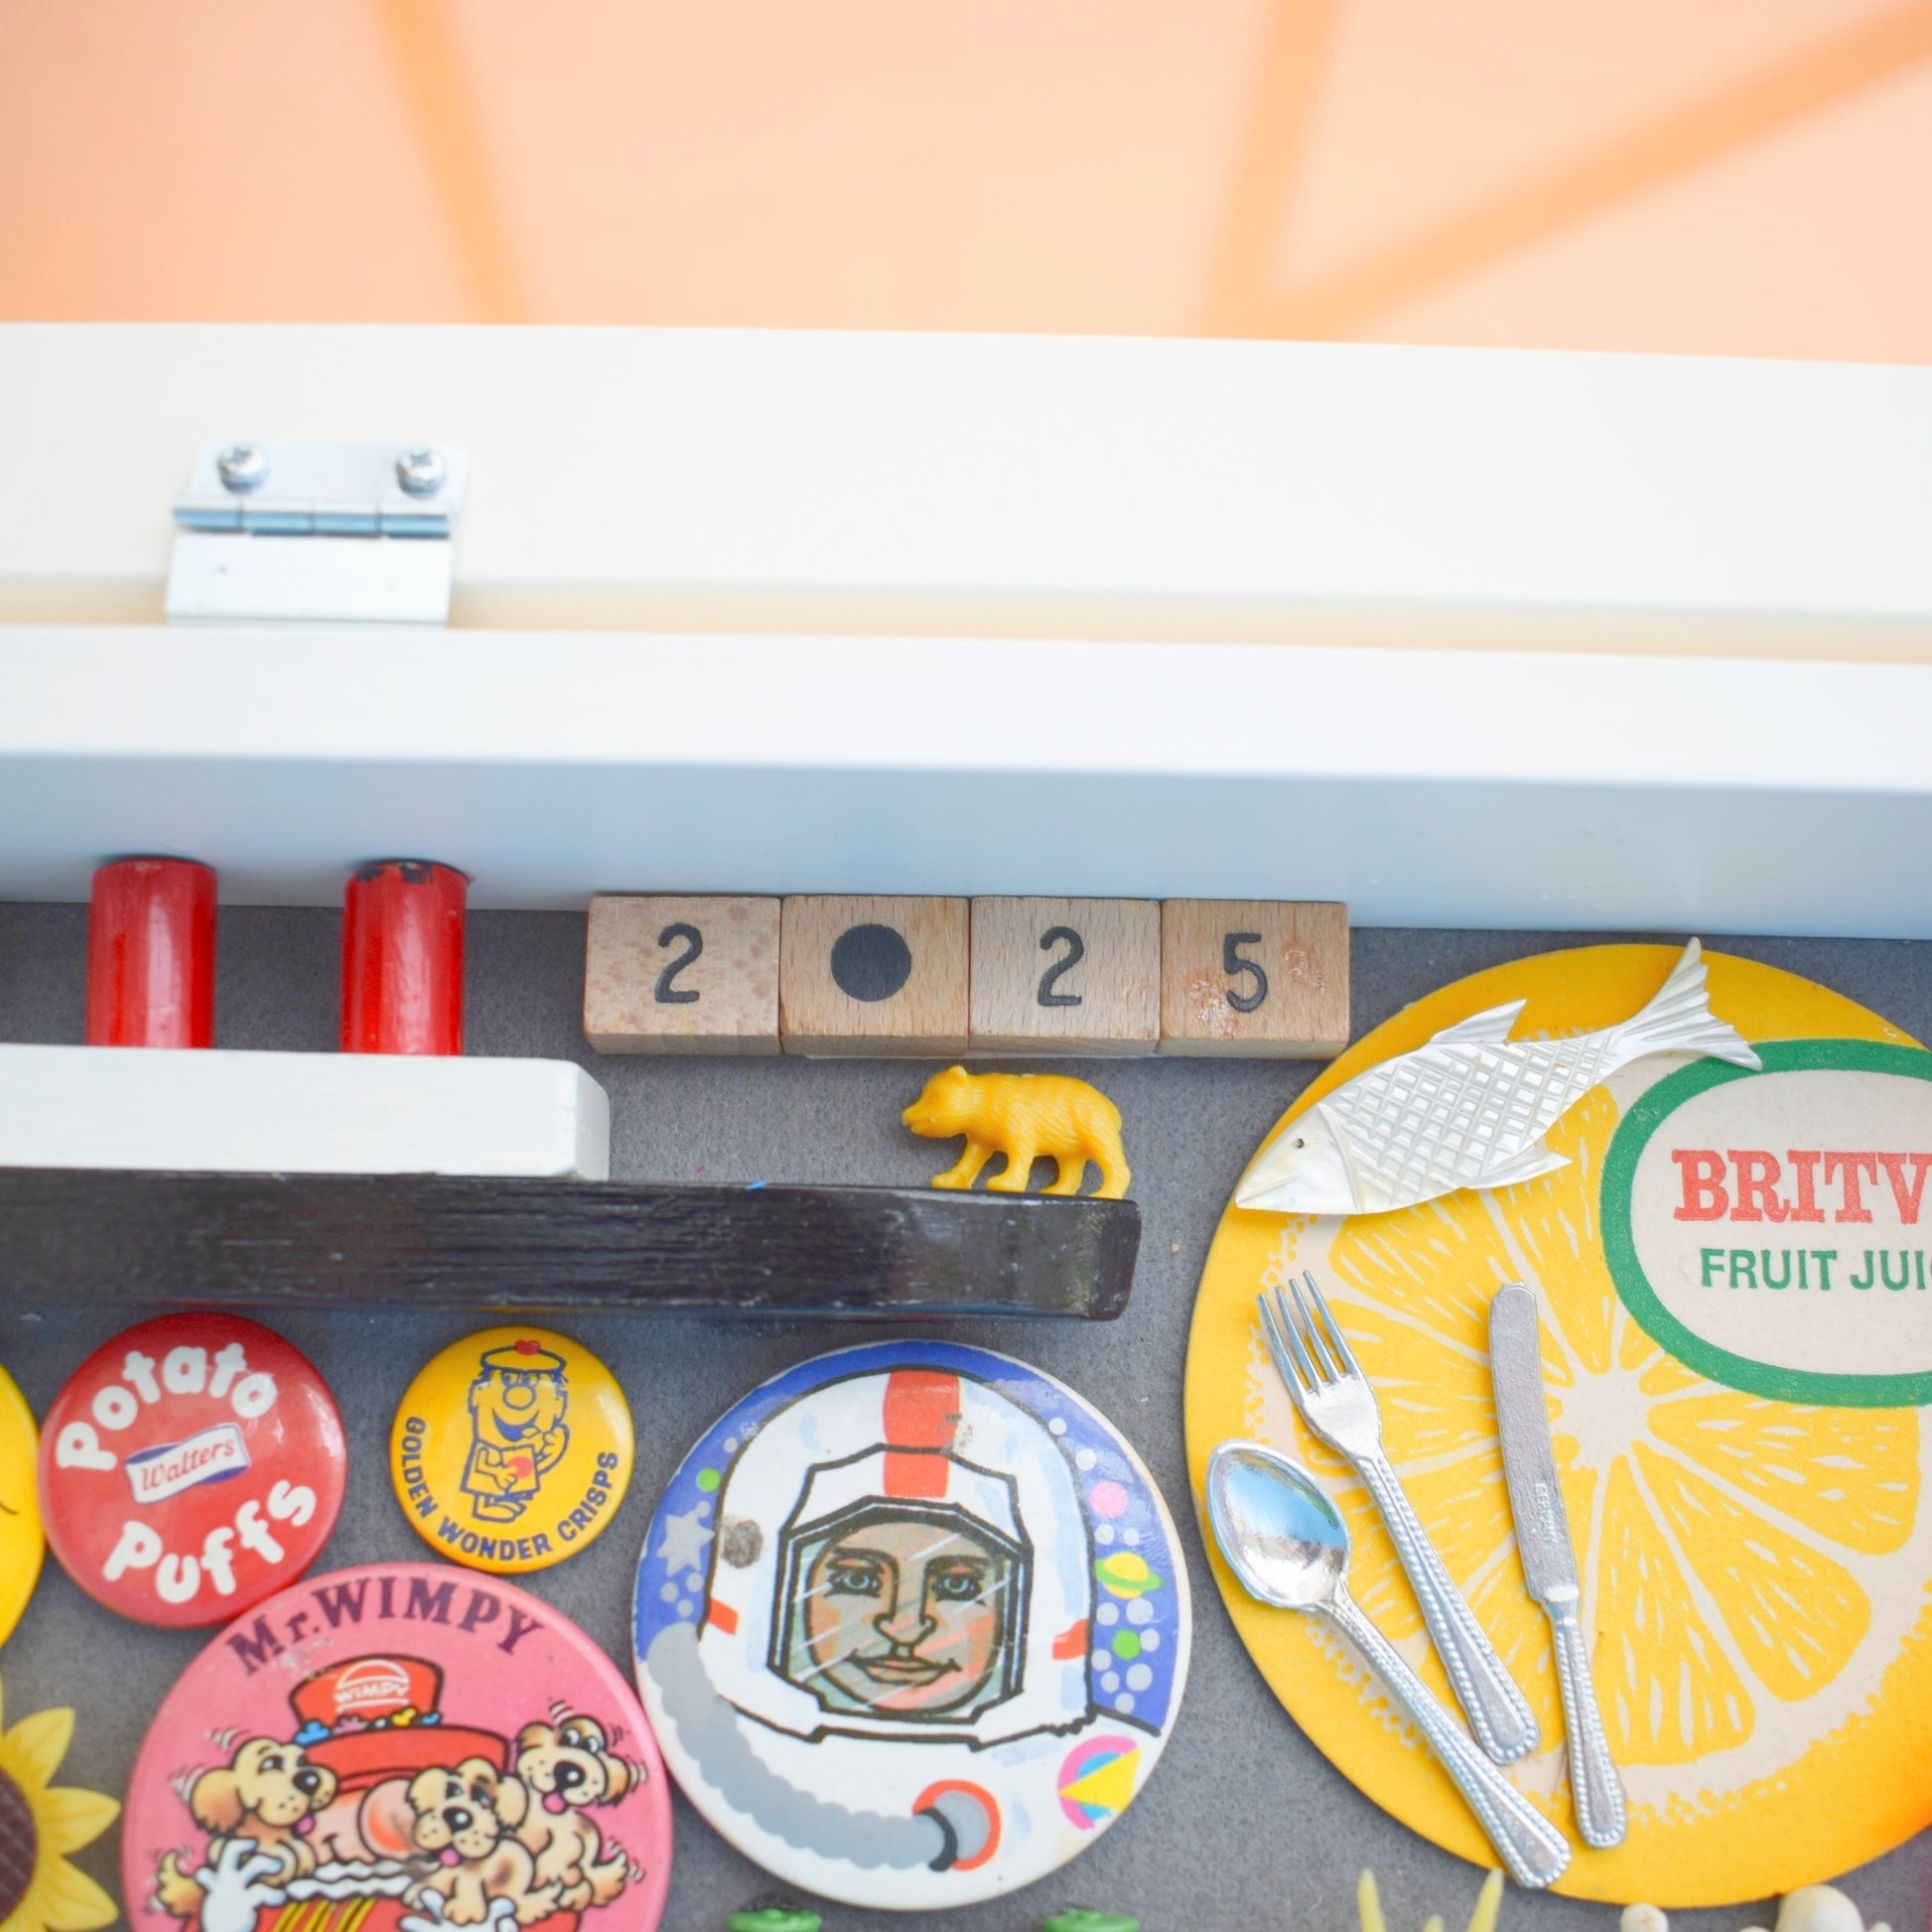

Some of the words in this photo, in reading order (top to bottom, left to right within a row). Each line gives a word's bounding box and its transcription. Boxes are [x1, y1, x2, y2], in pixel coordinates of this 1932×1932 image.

[1671, 1149, 1932, 1224] BRITV
[1700, 1248, 1838, 1291] FRUIT
[1850, 1249, 1932, 1292] JUI
[56, 1342, 278, 1471] Potato
[141, 1439, 234, 1490] Walters
[401, 1416, 439, 1518] GOLDEN
[437, 1515, 553, 1562] WONDER
[557, 1451, 620, 1541] CRISPS
[103, 1479, 317, 1604] Puffs
[334, 1681, 410, 1703] WIMPY
